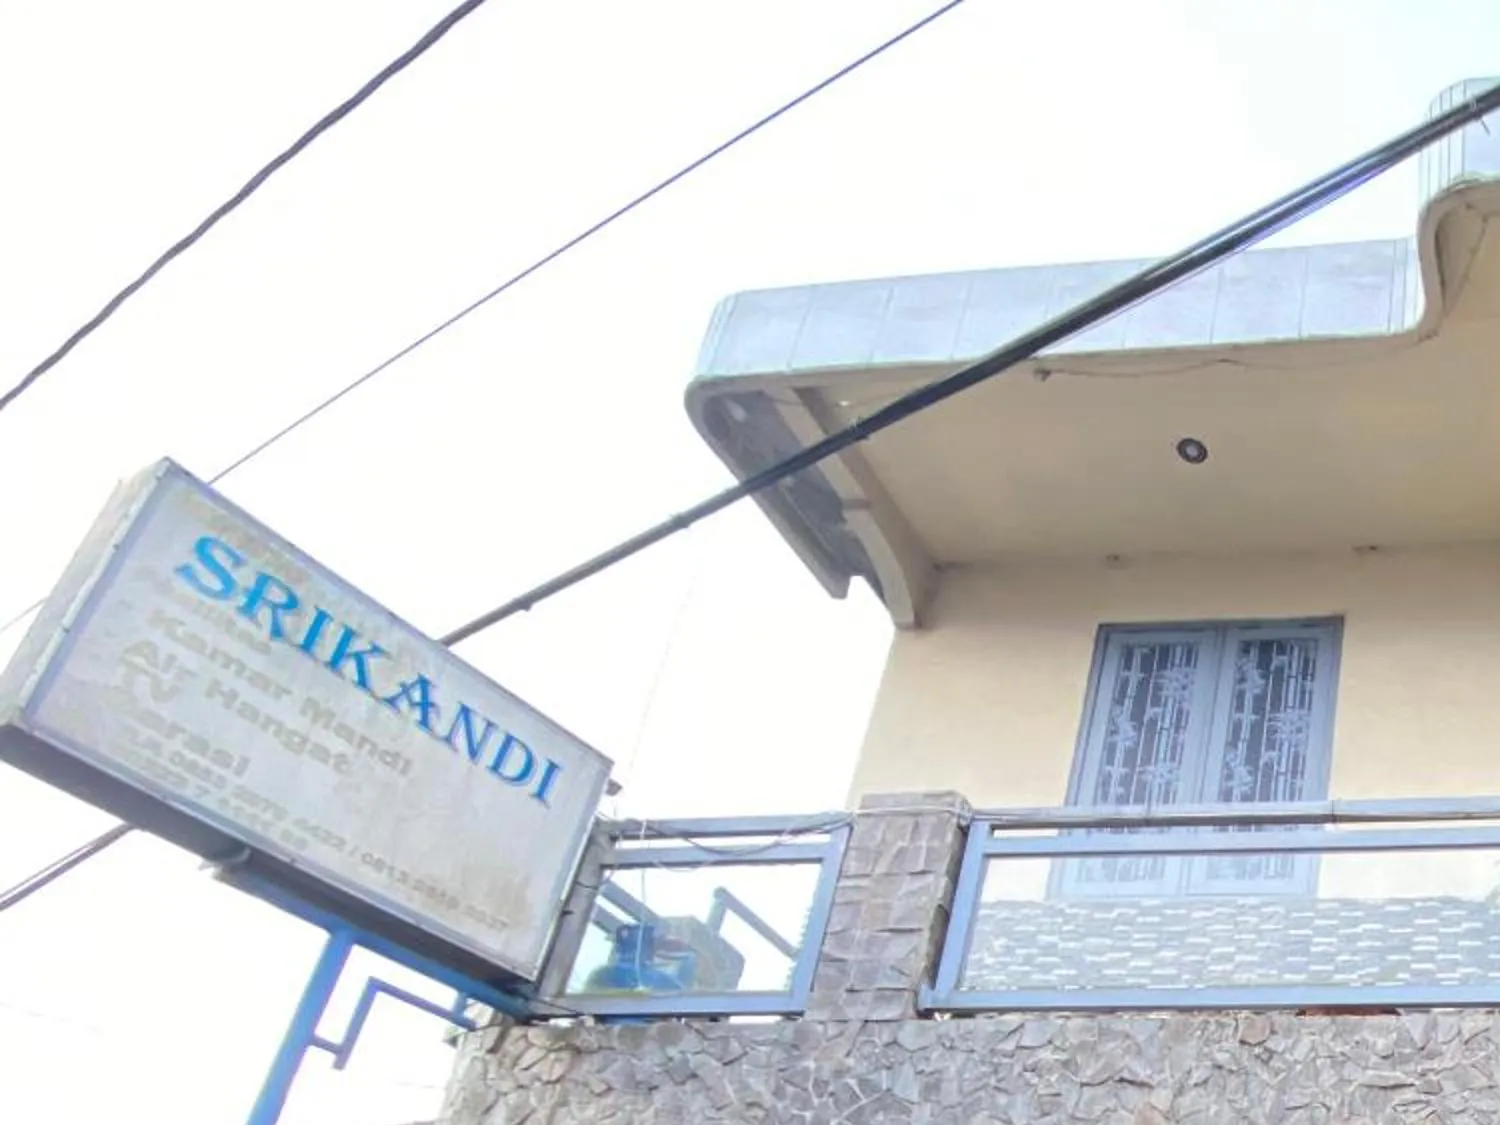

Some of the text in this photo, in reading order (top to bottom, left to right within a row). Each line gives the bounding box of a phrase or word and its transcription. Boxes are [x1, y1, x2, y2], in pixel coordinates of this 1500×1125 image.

[108, 654, 182, 710] TV
[123, 631, 199, 688] Air
[200, 677, 353, 780] Hangat
[143, 604, 415, 778] Kamar Mandi
[175, 535, 565, 806] SRIKANDI
